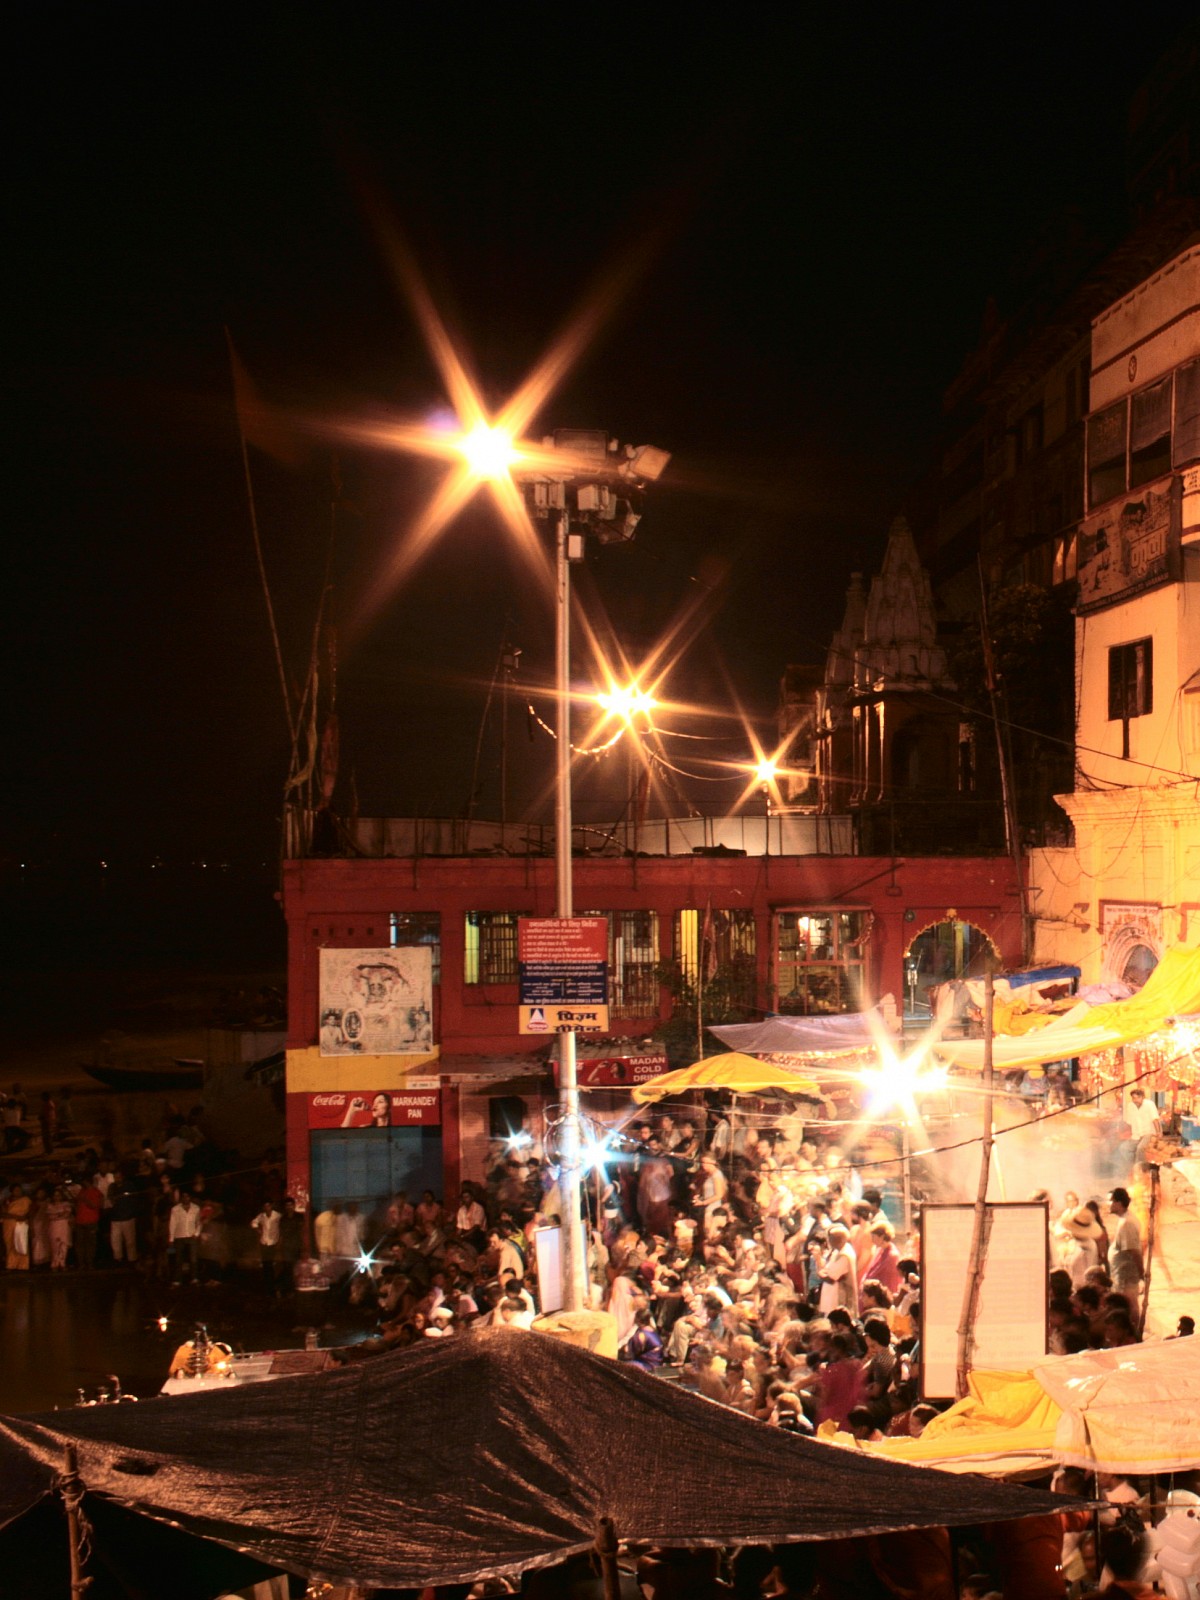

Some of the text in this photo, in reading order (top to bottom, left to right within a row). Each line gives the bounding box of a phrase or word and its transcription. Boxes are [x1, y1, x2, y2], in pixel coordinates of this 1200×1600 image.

[630, 1056, 665, 1065] MADAN
[634, 1065, 662, 1074] COLD
[392, 1096, 437, 1107] MARKANDEY
[407, 1108, 422, 1119] PAN
